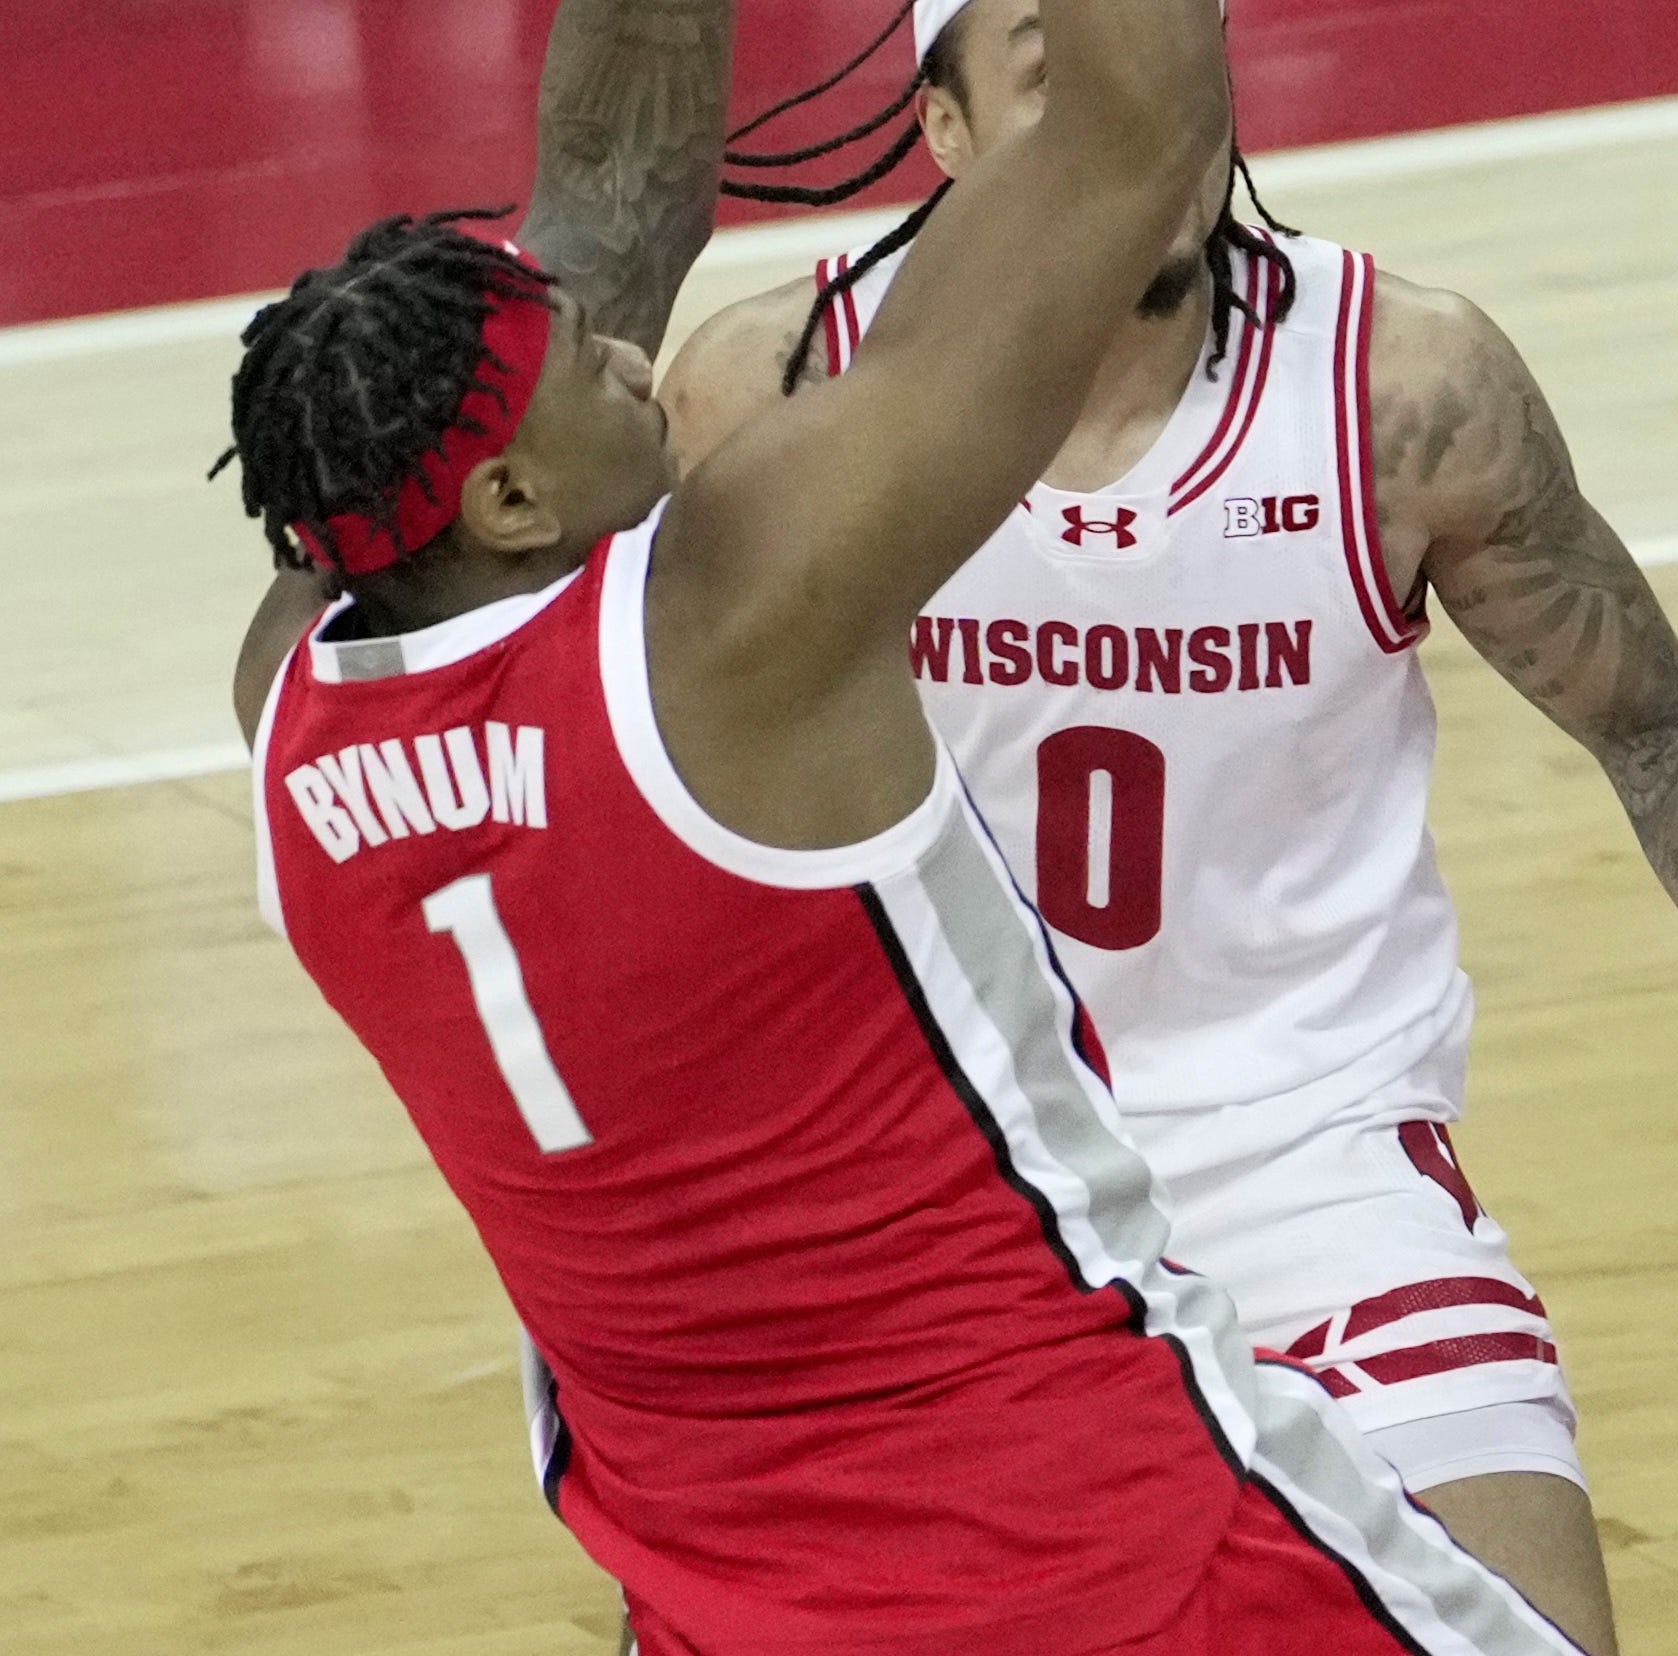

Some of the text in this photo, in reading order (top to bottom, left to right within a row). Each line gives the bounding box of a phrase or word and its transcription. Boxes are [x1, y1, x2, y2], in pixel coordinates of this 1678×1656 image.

[908, 615, 1313, 695] WISCONSIN
[284, 720, 548, 865] BYNUM
[1036, 725, 1166, 951] 0
[421, 873, 596, 1155] 1
